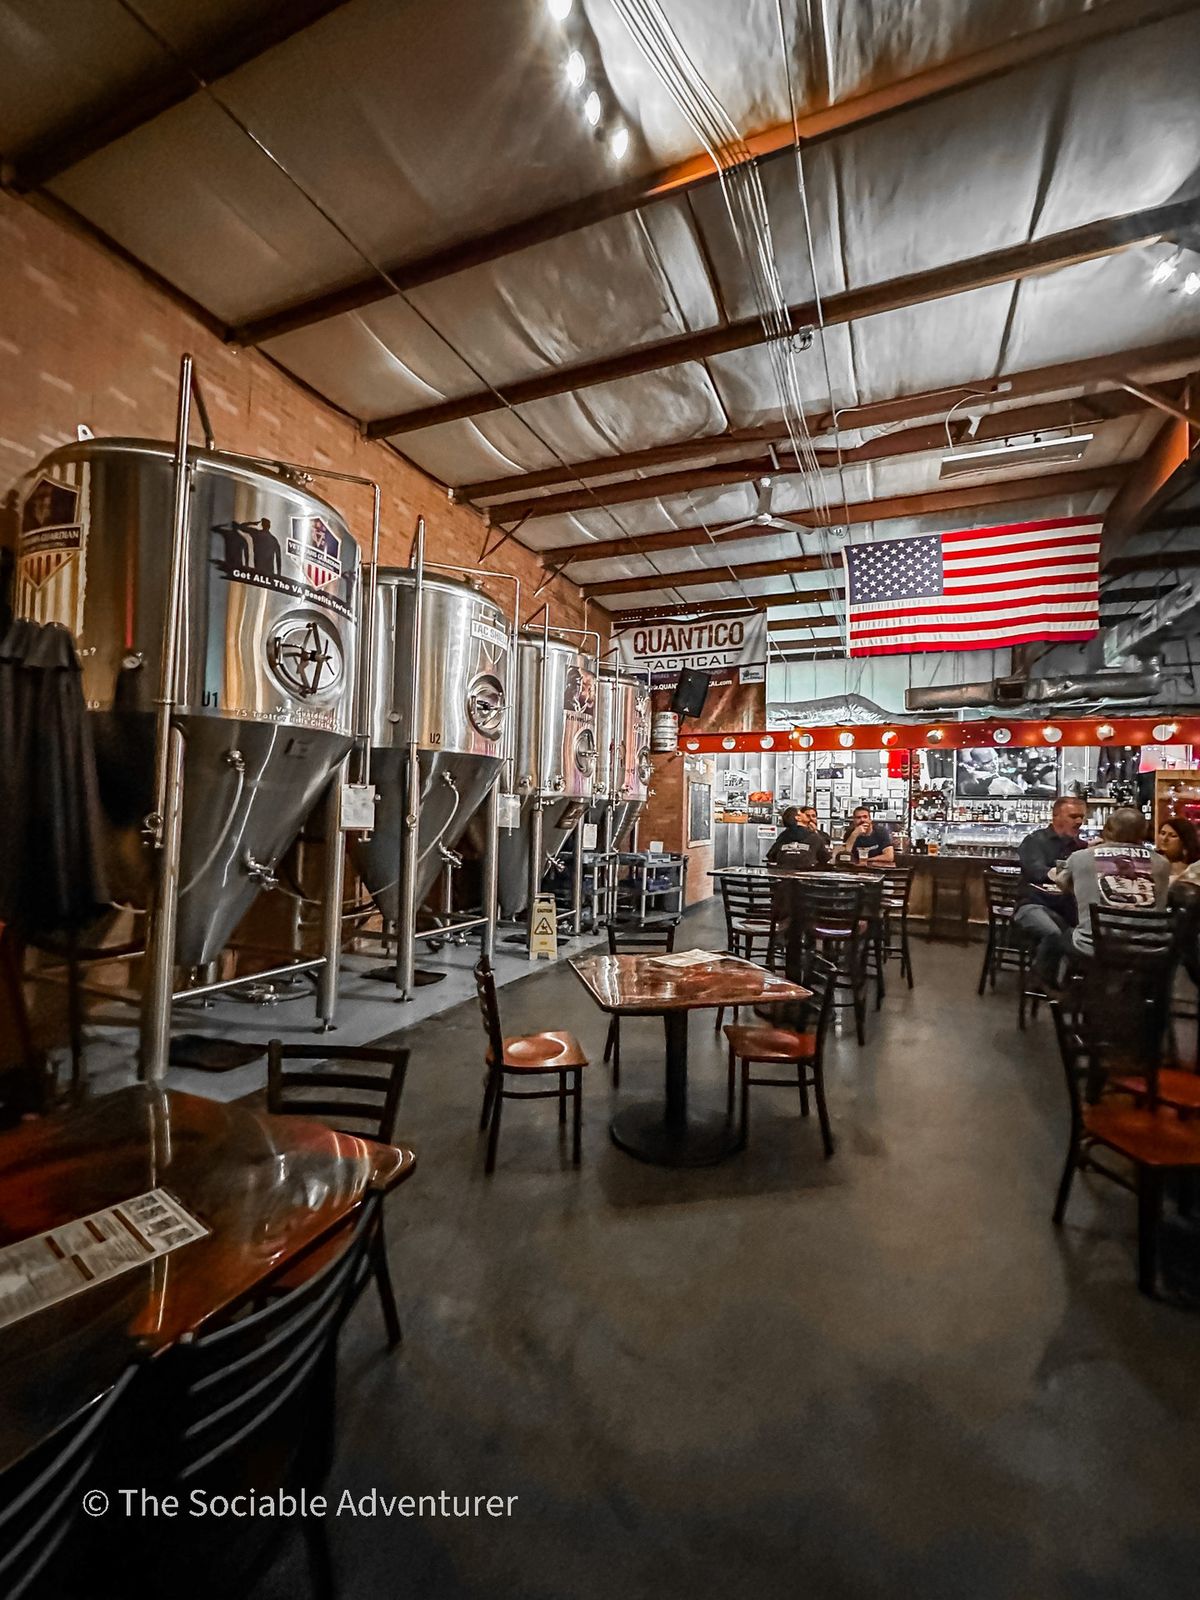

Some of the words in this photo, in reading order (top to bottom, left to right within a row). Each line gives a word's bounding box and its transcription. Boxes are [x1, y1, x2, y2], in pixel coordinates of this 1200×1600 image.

[233, 569, 251, 580] Get
[253, 574, 271, 586] ALL
[274, 579, 290, 590] The
[292, 585, 303, 595] VA
[304, 589, 332, 606] Benefits
[473, 622, 489, 636] TAC
[633, 622, 744, 655] QUANTICO
[644, 655, 733, 671] TACTICAL
[202, 691, 218, 707] U1
[430, 732, 441, 745] U2
[1094, 847, 1151, 859] LEGEND
